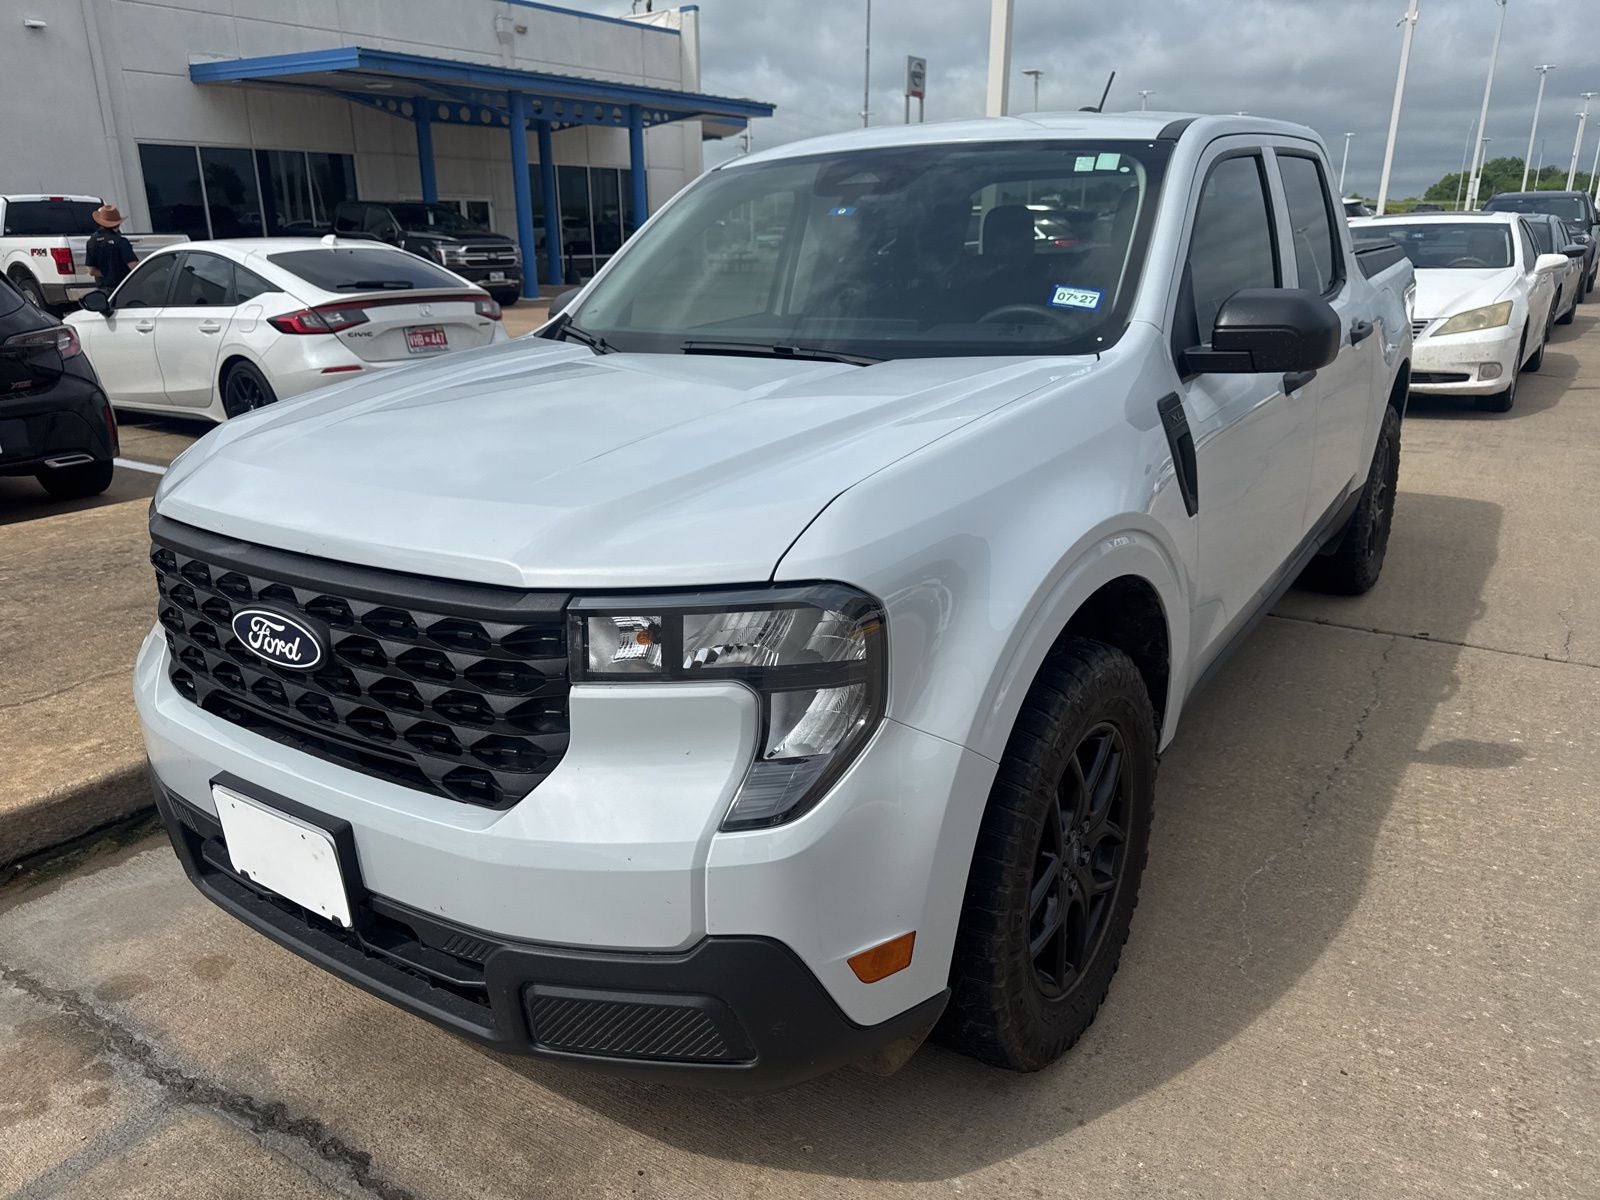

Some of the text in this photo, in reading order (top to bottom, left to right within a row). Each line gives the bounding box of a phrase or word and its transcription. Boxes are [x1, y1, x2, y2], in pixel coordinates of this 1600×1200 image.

[30, 247, 47, 257] FX4
[1057, 292, 1096, 304] 07 27
[248, 616, 302, 661] Ford
